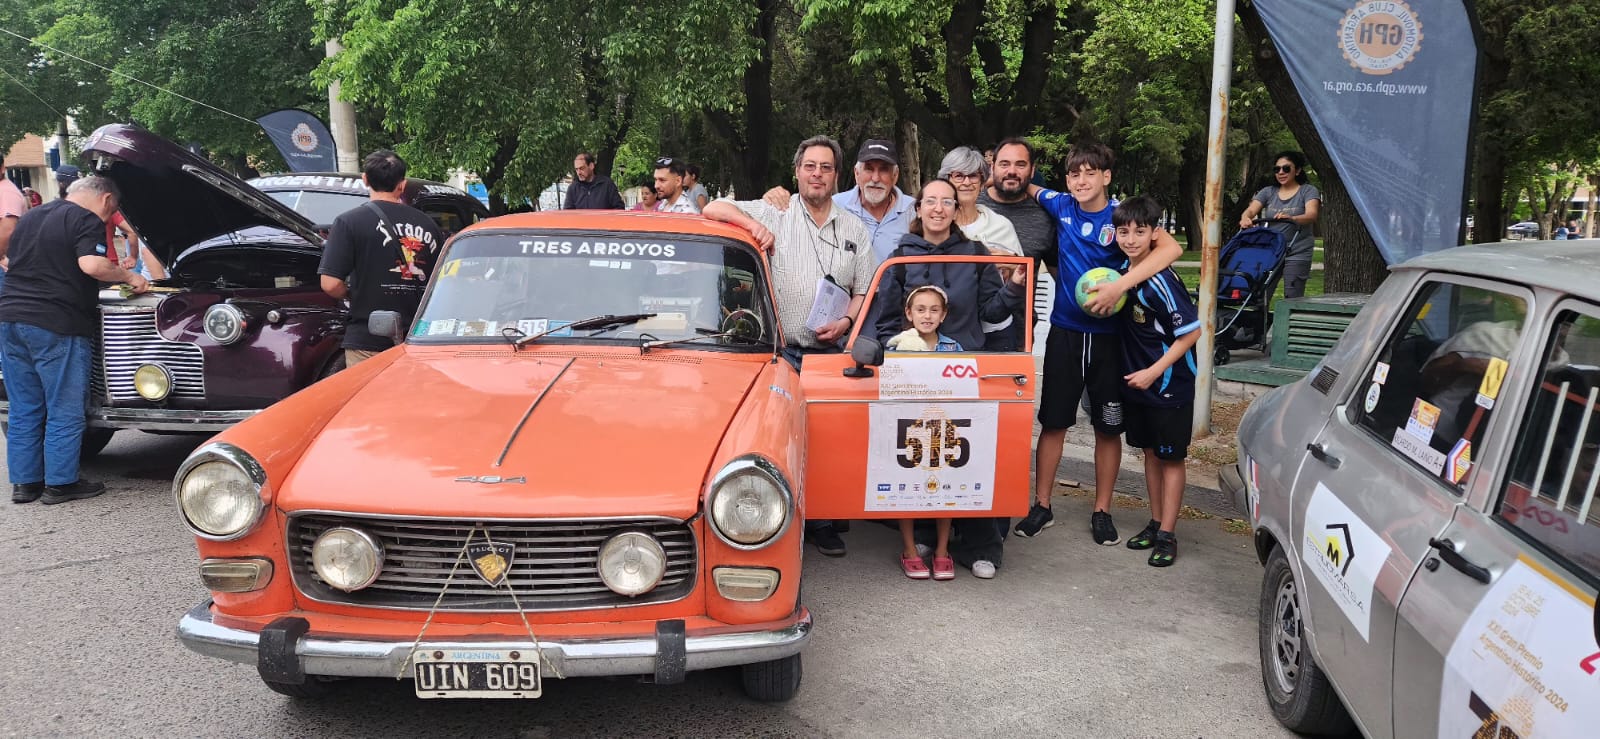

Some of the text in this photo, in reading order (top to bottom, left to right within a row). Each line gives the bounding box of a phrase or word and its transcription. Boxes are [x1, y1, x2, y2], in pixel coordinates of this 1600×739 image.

[245, 176, 371, 191] ARGENTIN
[519, 241, 676, 258] TRES ARROYOS
[520, 321, 546, 335] 515
[942, 364, 978, 379] ACA
[896, 418, 972, 469] 515
[1326, 541, 1339, 568] M
[451, 652, 501, 660] ARGENTINA
[1500, 629, 1519, 648] Gran
[1518, 642, 1544, 671] Premio
[418, 663, 535, 690] UIN 609
[1479, 633, 1512, 665] Argentino
[1512, 658, 1545, 694] Histórico
[1545, 688, 1569, 713] 2024
